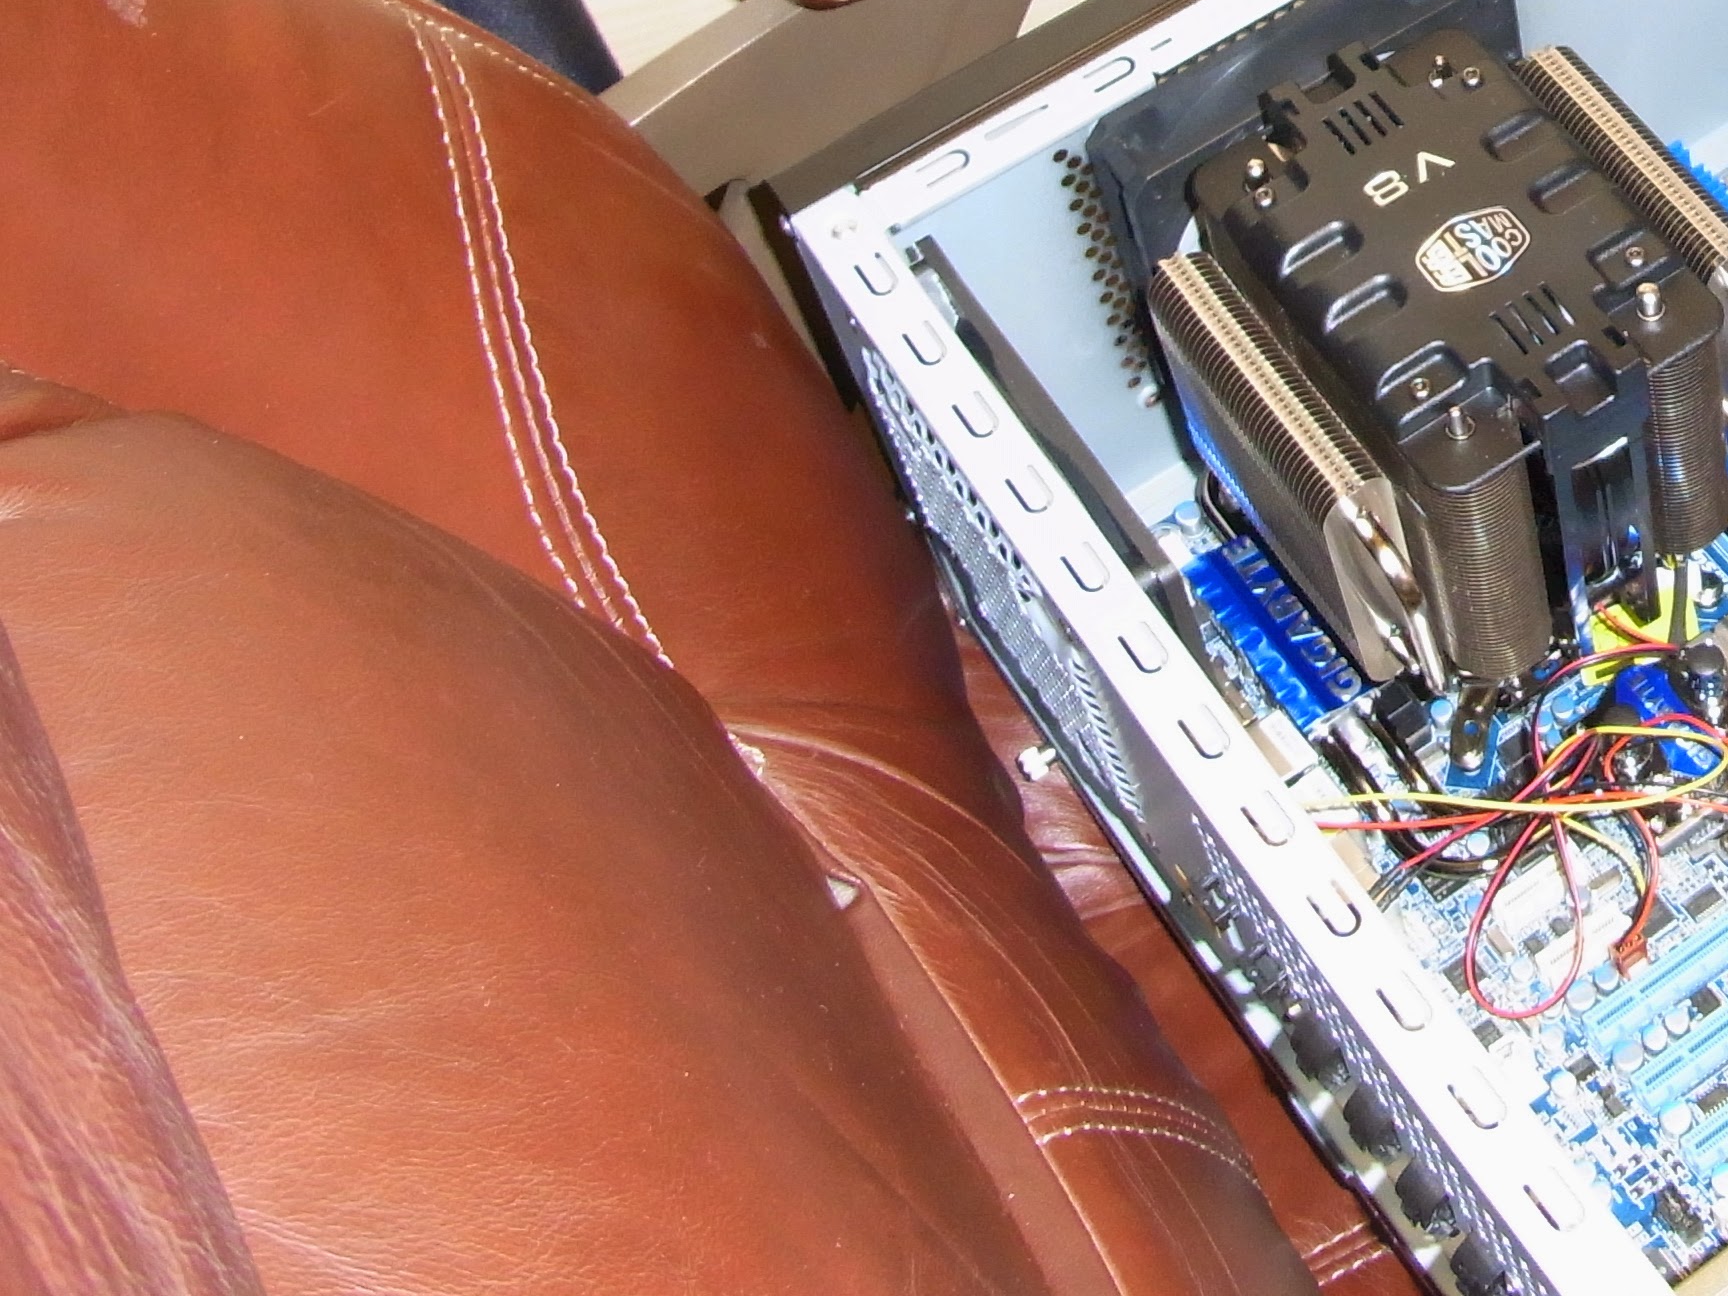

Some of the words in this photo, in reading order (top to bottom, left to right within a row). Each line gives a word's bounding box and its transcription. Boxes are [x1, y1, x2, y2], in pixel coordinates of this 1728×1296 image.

[1363, 151, 1455, 206] V8
[1421, 213, 1512, 270] MASTER
[1431, 228, 1523, 287] COOLER
[1222, 536, 1363, 703] GIGABYTE
